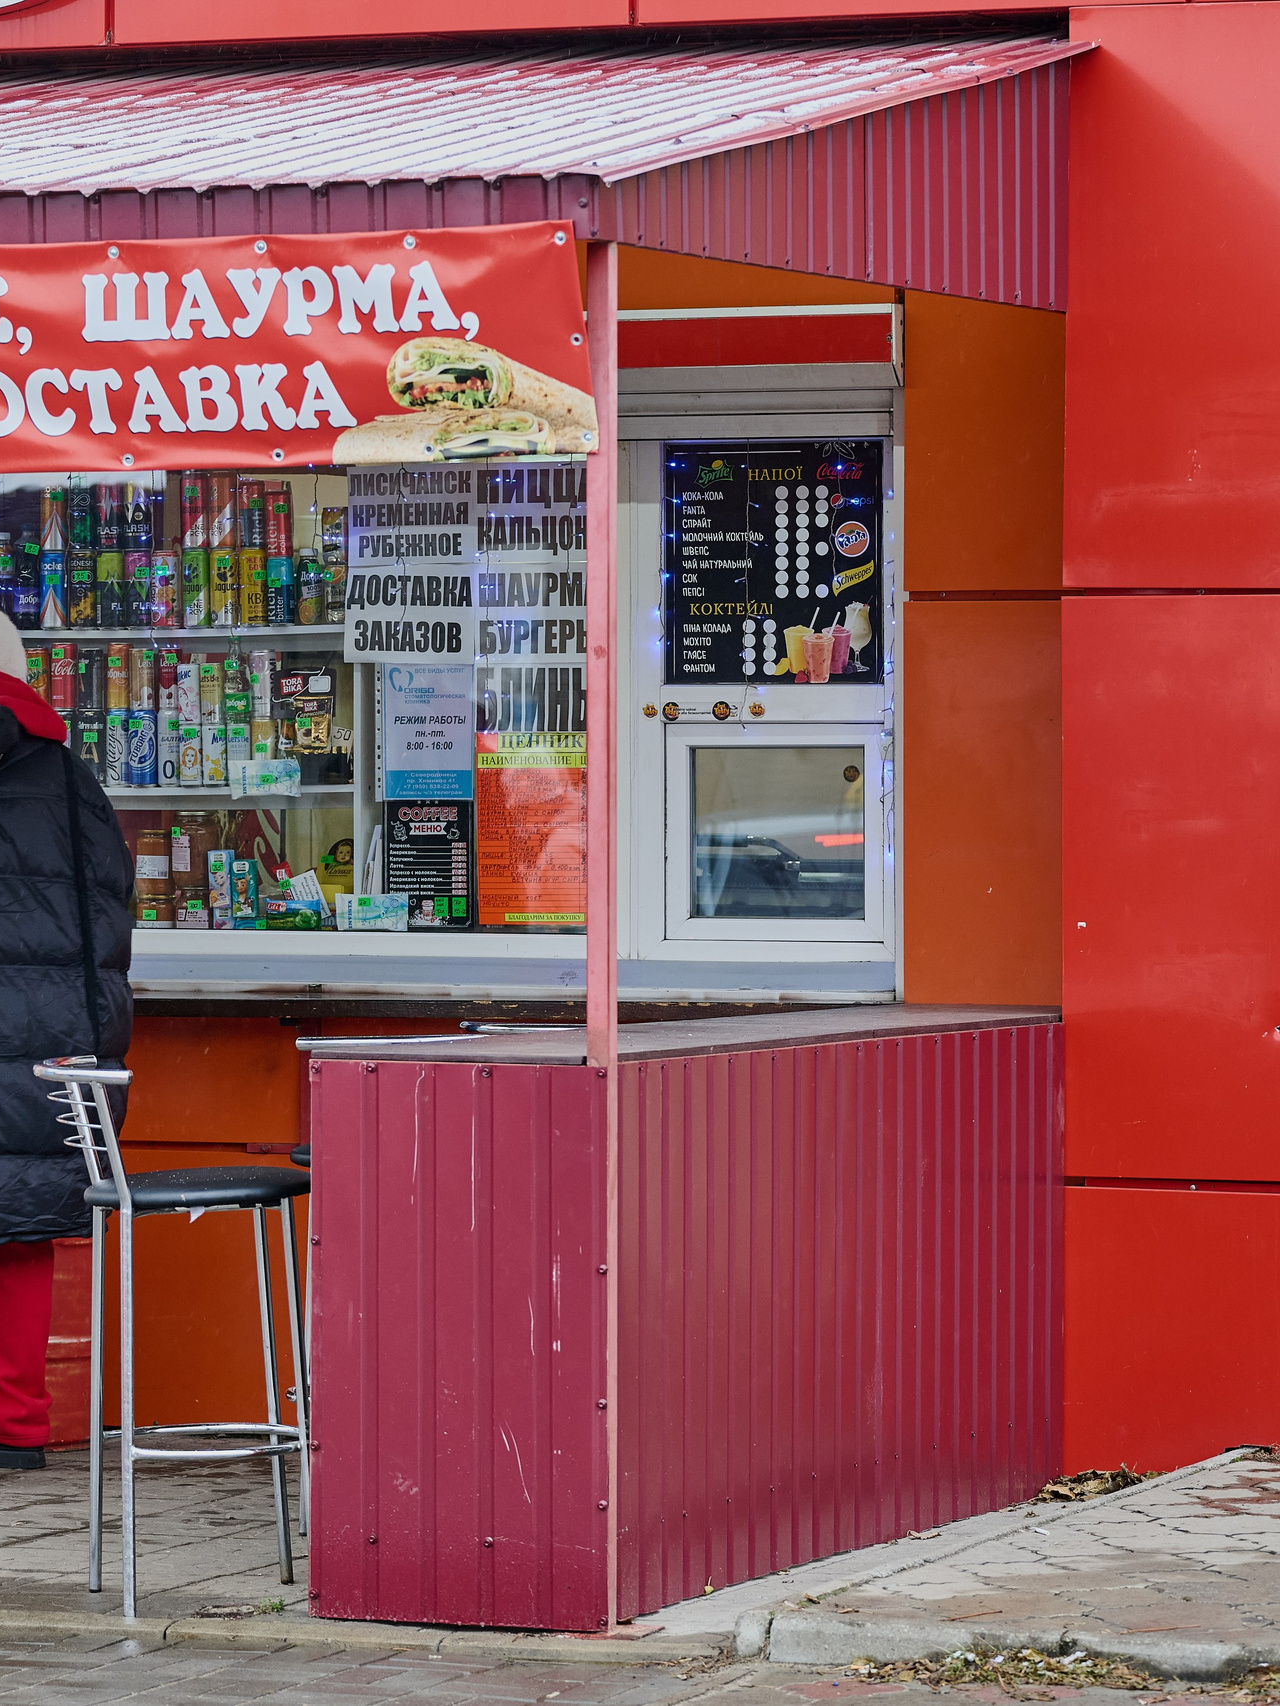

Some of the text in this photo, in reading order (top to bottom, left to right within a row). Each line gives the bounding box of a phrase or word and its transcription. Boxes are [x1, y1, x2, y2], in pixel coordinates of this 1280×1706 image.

[81, 260, 480, 342] ШАУРМА,
[700, 466, 731, 483] Sprite
[749, 466, 803, 481] НАПОЇ
[350, 470, 472, 496] ЛИСИЧАНСК
[682, 491, 724, 501] КОКА-КОЛА
[352, 501, 469, 527] КРЕМЕННАЯ
[682, 505, 706, 515] FANTA
[253, 510, 264, 543] Rich
[682, 518, 712, 529] СПРАЙТ
[267, 520, 278, 554] Rich
[682, 531, 764, 542] МОЛОЧНИЙ КОКТЕЙЛЬ
[279, 534, 287, 553] cola
[359, 532, 462, 558] РУБЕЖНОЕ
[682, 546, 710, 556] ШВЕПС
[682, 558, 753, 570] ЧАЙ НАТУРАЛЬНИЙ
[682, 573, 698, 583] СОК
[347, 574, 472, 610] ДОСТАВКА
[478, 572, 586, 608] ШАУРМ
[682, 587, 705, 597] ПЕПСІ
[276, 596, 284, 620] bitter
[690, 599, 774, 616] КОКТЕЙЛІ
[683, 623, 732, 634] ПІНА КОЛАДА
[354, 620, 462, 653] ЗАКАЗОВ
[683, 636, 712, 647] МОХІТО
[683, 650, 707, 660] ГЛЯСЕ
[683, 663, 716, 673] ФАНТОМ
[280, 677, 303, 687] TORA
[282, 684, 303, 694] BIKA
[394, 715, 466, 725] РЕЖИМ РАБОТЫ
[333, 728, 352, 742] 50
[415, 729, 446, 738] пн.-пт.
[129, 727, 150, 763] TUBORG
[406, 741, 424, 750] 8:00
[431, 741, 454, 750] 16:00
[501, 733, 585, 749] ЦЕННИК
[481, 755, 572, 766] НАИМЕНОВАНИЕ
[162, 759, 176, 779] 0
[398, 806, 458, 821] COFFEE
[413, 825, 442, 833] МЕНЮ
